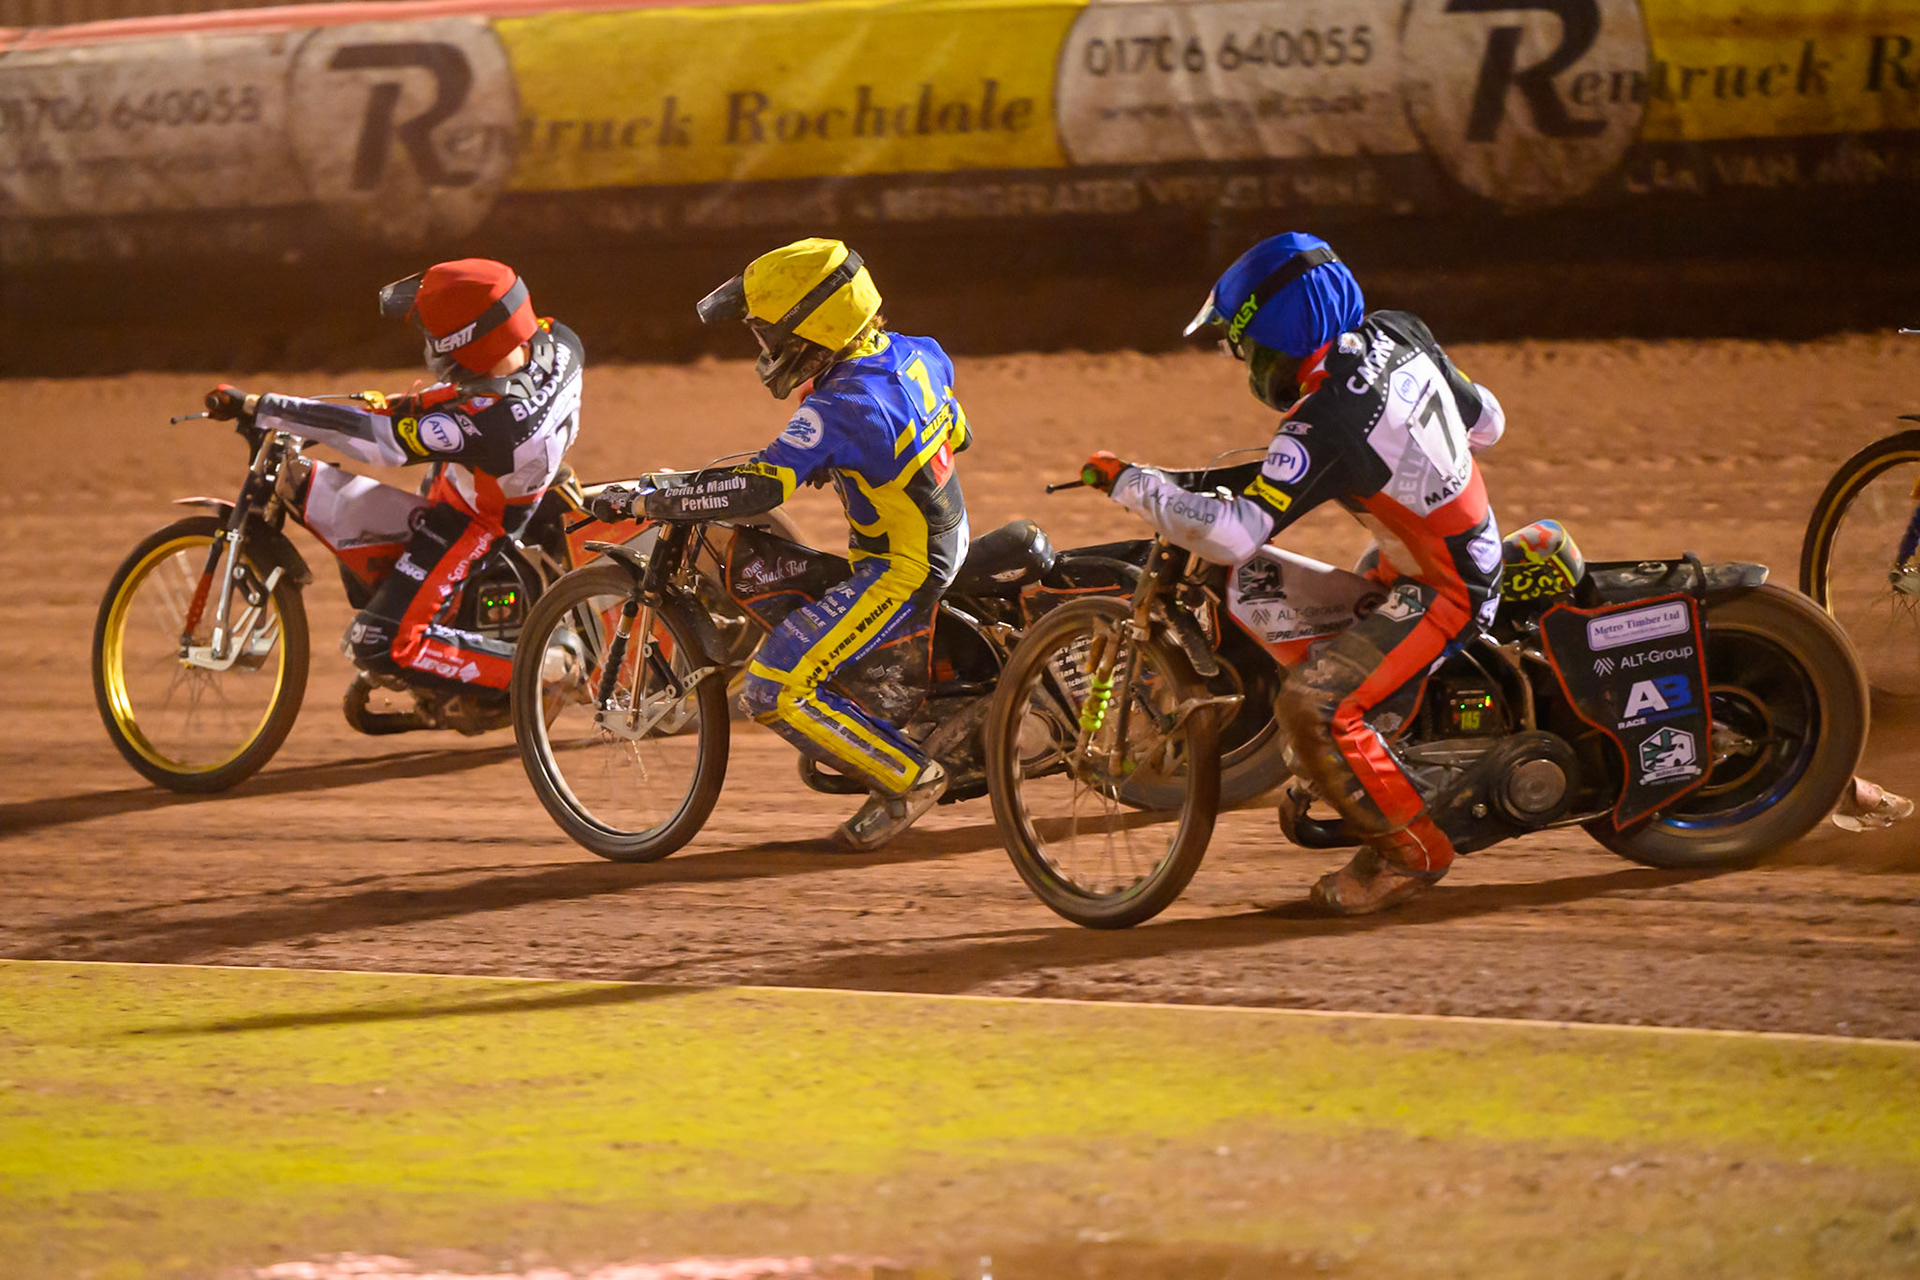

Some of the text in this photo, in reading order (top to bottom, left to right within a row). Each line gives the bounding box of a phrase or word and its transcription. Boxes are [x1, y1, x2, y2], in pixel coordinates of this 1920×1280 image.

[1085, 25, 1373, 76] 01706 640055
[724, 78, 1035, 146] Rochdale
[435, 322, 477, 353] LEATT
[905, 357, 937, 415] 1
[428, 420, 453, 448] ATPI
[1418, 389, 1457, 463] 7
[695, 483, 705, 495] &
[706, 475, 747, 493] Mandy
[681, 495, 729, 512] Perkins
[755, 556, 808, 585] Snack Bar
[829, 632, 858, 661] Lynne
[854, 597, 895, 634] Whitley
[1594, 623, 1623, 636] Metro
[1625, 615, 1662, 630] Timber
[1663, 610, 1680, 621] Ltd
[1620, 645, 1694, 669] ALT-Group
[1623, 674, 1692, 718] AB
[1460, 711, 1480, 730] 145
[1617, 717, 1647, 730] RACE
